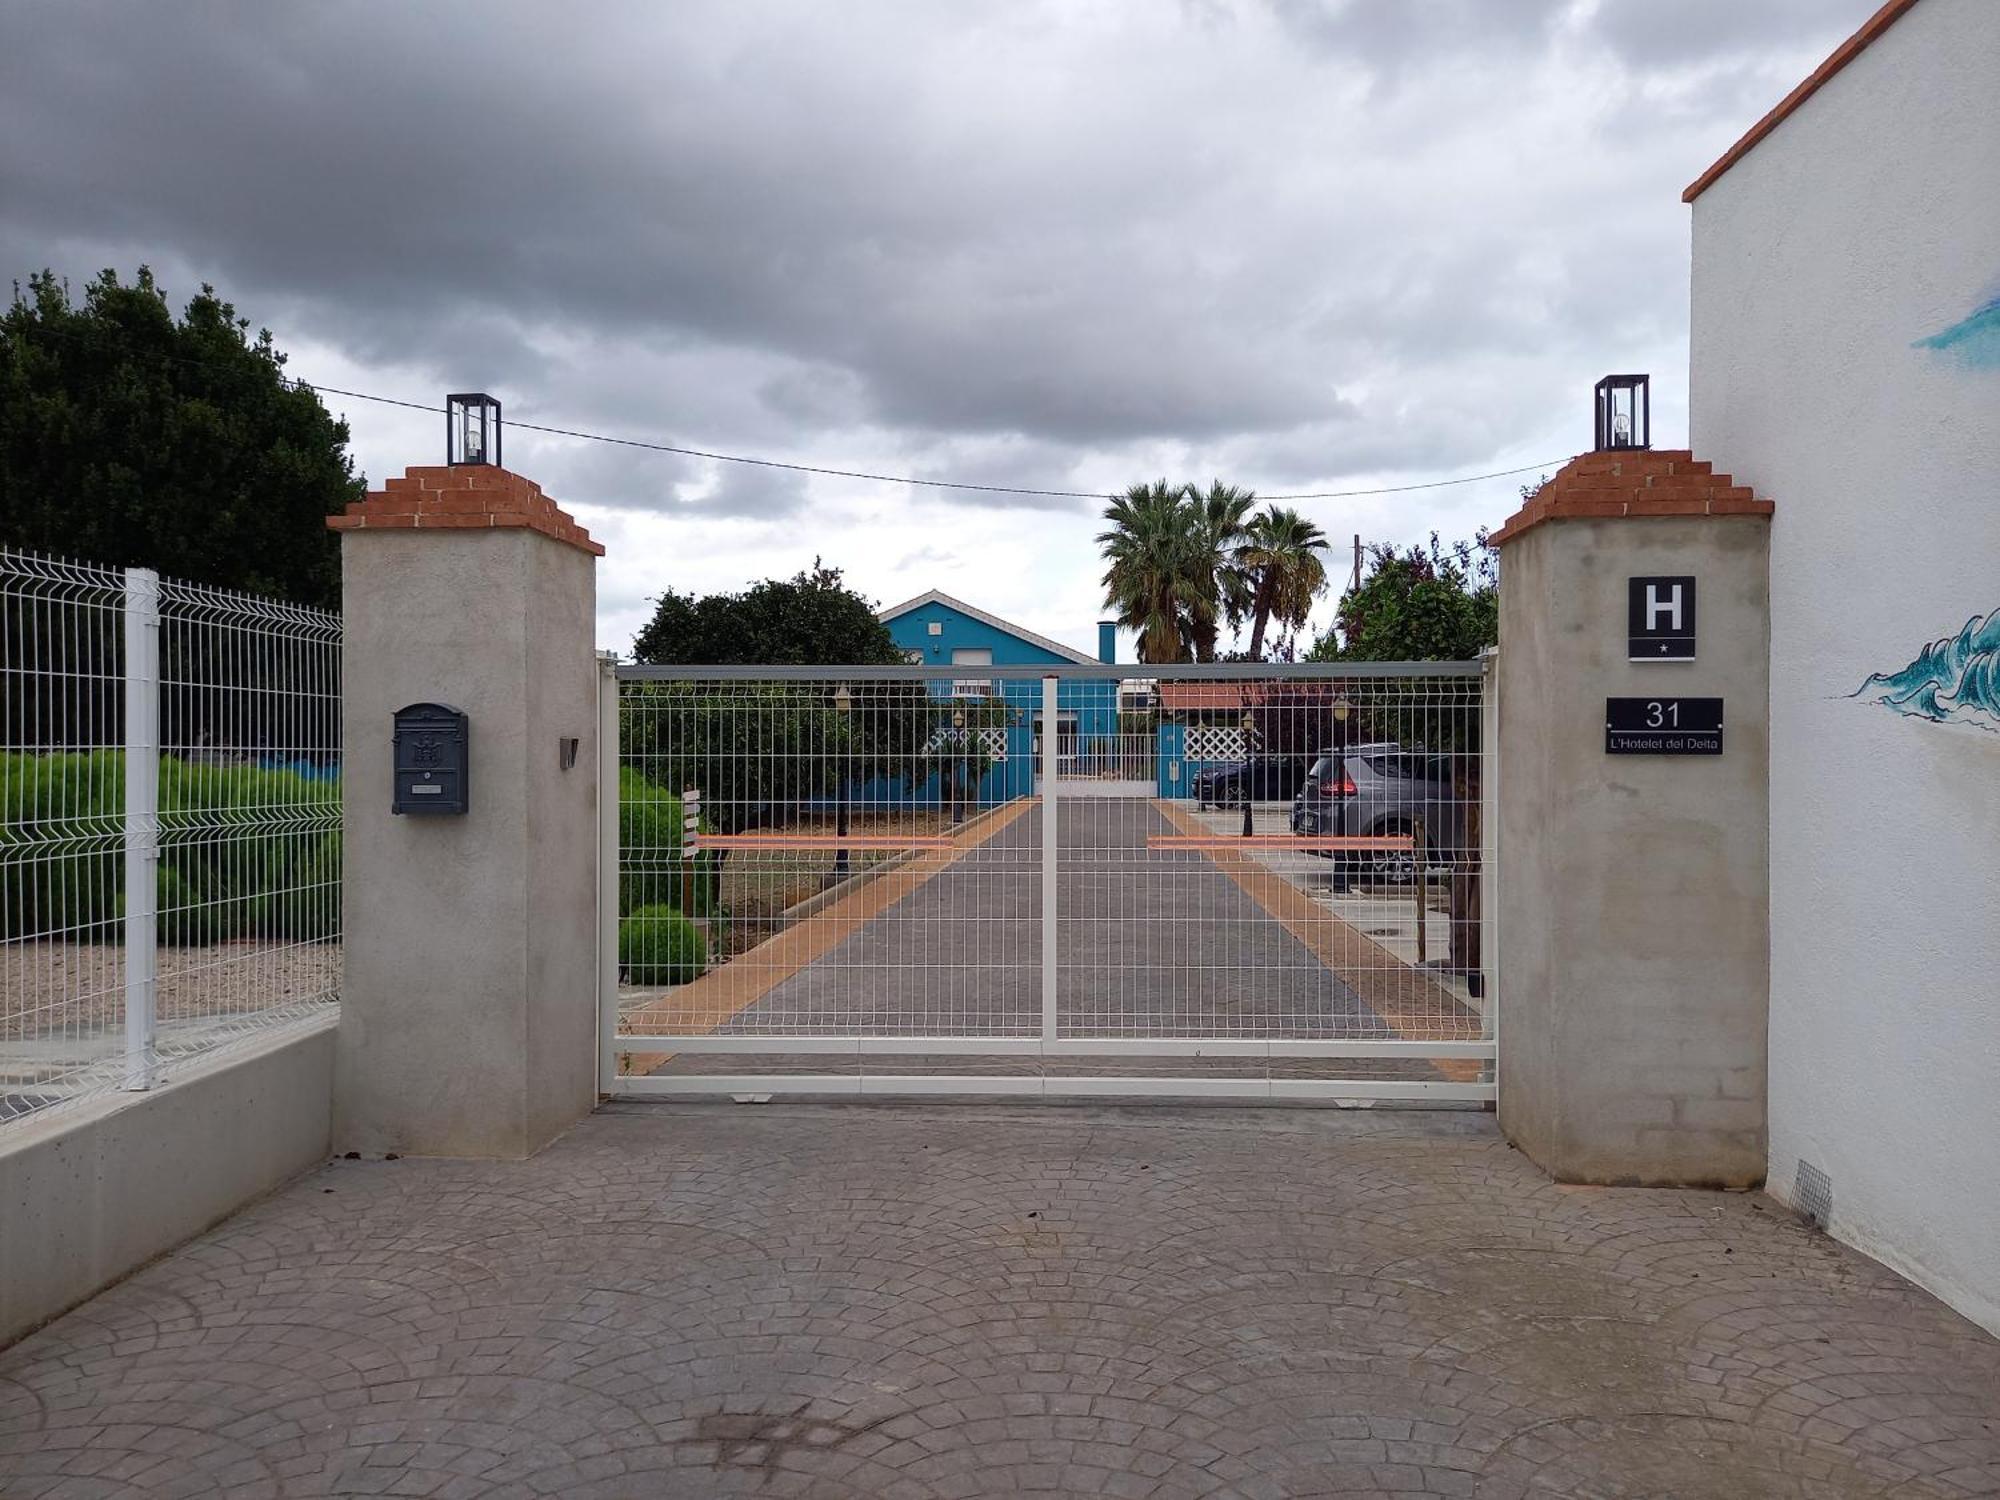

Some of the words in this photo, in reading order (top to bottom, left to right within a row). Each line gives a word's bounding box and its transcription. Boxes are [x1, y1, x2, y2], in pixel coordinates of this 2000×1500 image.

[1646, 584, 1683, 630] H
[1646, 702, 1680, 728] 31
[1610, 738, 1662, 749] L'Hotelet
[1666, 738, 1683, 749] del
[1687, 738, 1718, 749] Delta
